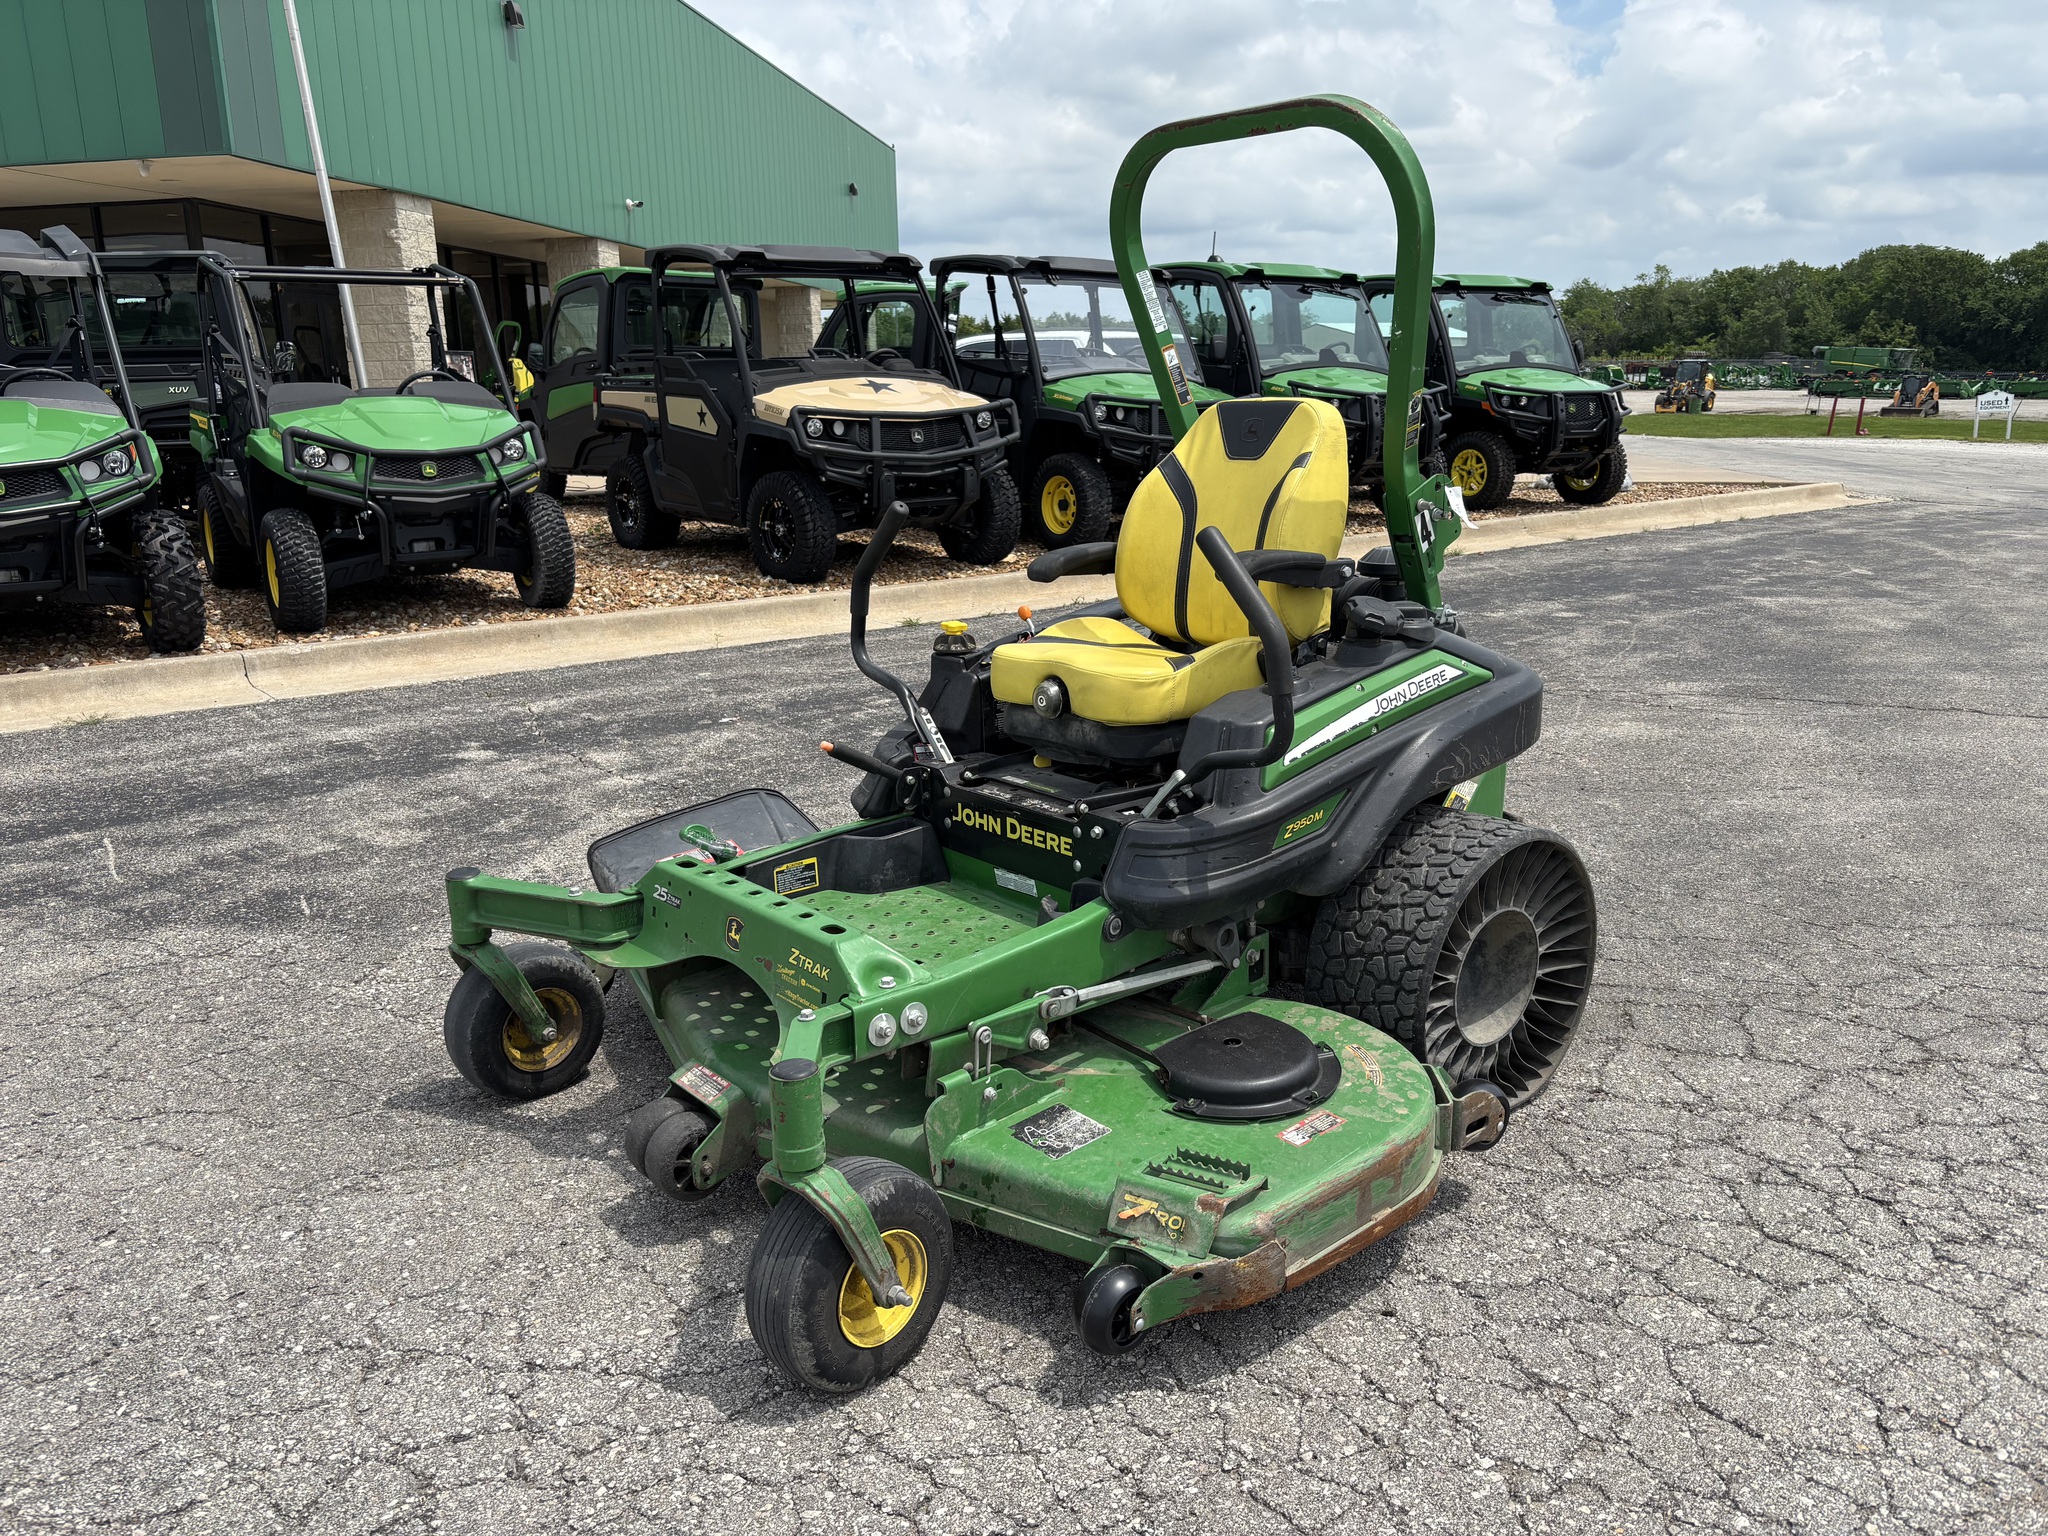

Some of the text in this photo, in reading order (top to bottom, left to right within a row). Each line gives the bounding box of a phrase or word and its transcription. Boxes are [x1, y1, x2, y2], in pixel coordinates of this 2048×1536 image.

[167, 385, 190, 394] XUV
[1420, 511, 1433, 547] 4
[1374, 669, 1448, 715] JOHN DEERE
[952, 802, 1002, 835] JOHN
[1006, 816, 1073, 857] DEERE
[1283, 809, 1324, 839] Z950M
[652, 884, 668, 902] 25
[788, 947, 831, 982] ZTRAK
